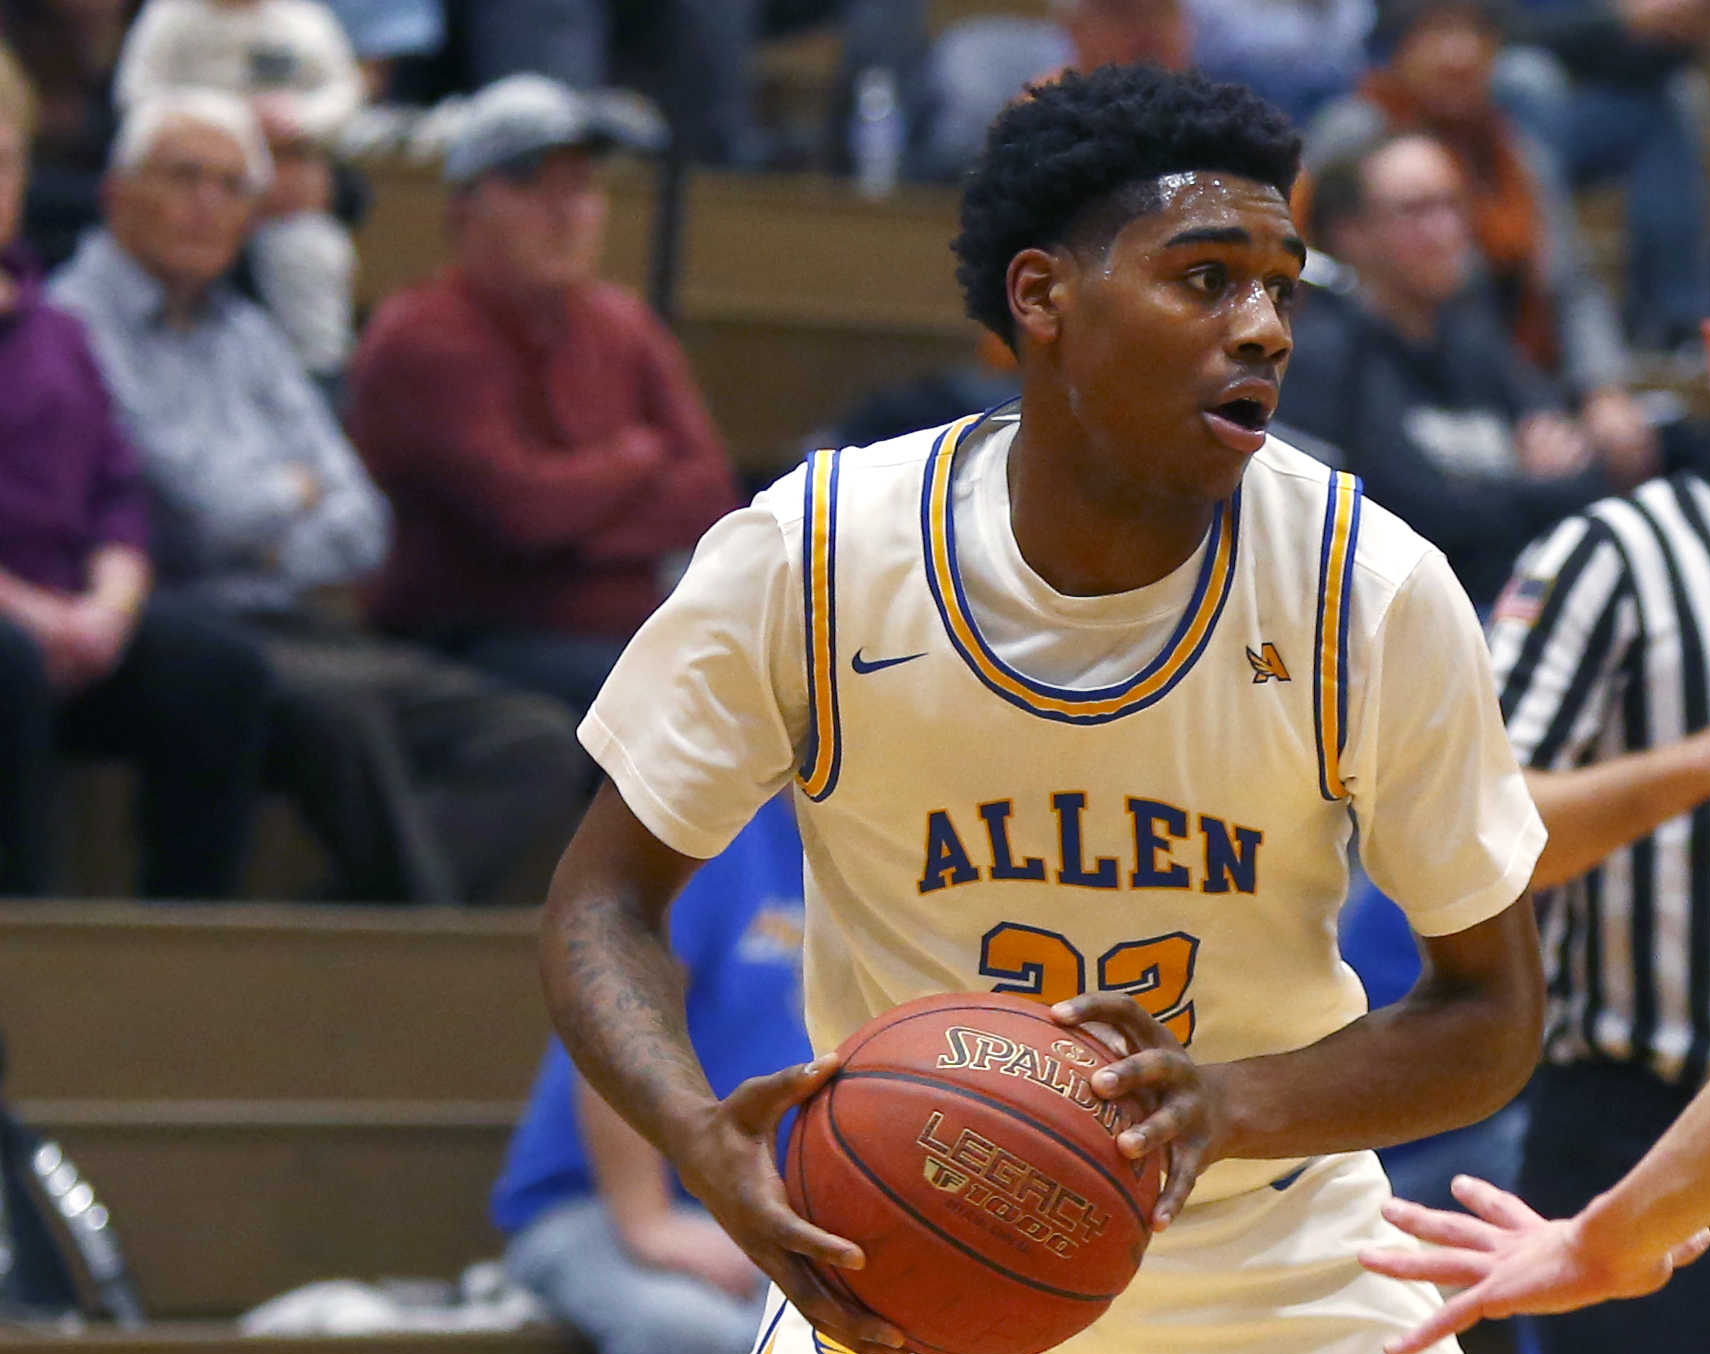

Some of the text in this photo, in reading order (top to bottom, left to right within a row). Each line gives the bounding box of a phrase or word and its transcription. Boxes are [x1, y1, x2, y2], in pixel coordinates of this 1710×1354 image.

[918, 791, 1262, 894] ALLEN
[979, 921, 1200, 1048] 22
[916, 1111, 1112, 1242] LEGACY
[964, 1183, 1080, 1259] 1000
